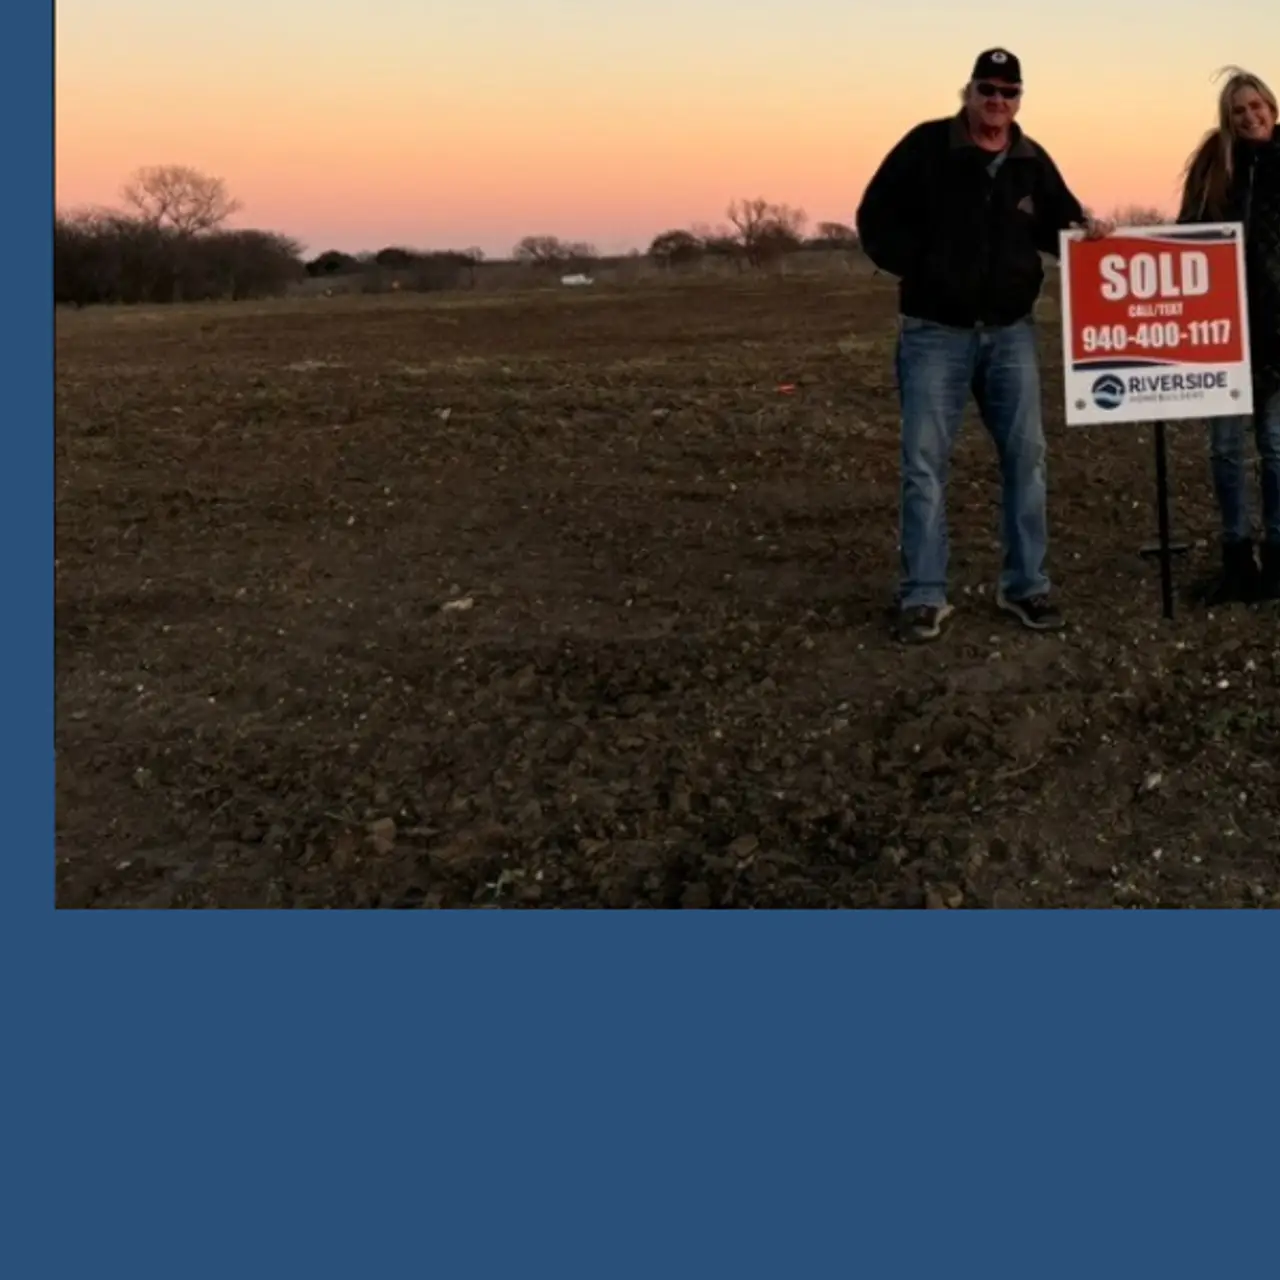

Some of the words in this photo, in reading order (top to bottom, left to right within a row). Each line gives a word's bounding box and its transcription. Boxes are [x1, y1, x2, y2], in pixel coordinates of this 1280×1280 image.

[1099, 251, 1209, 301] SOLD
[1082, 319, 1231, 352] 940-400-1117
[1128, 371, 1228, 392] RIVERSIDE
